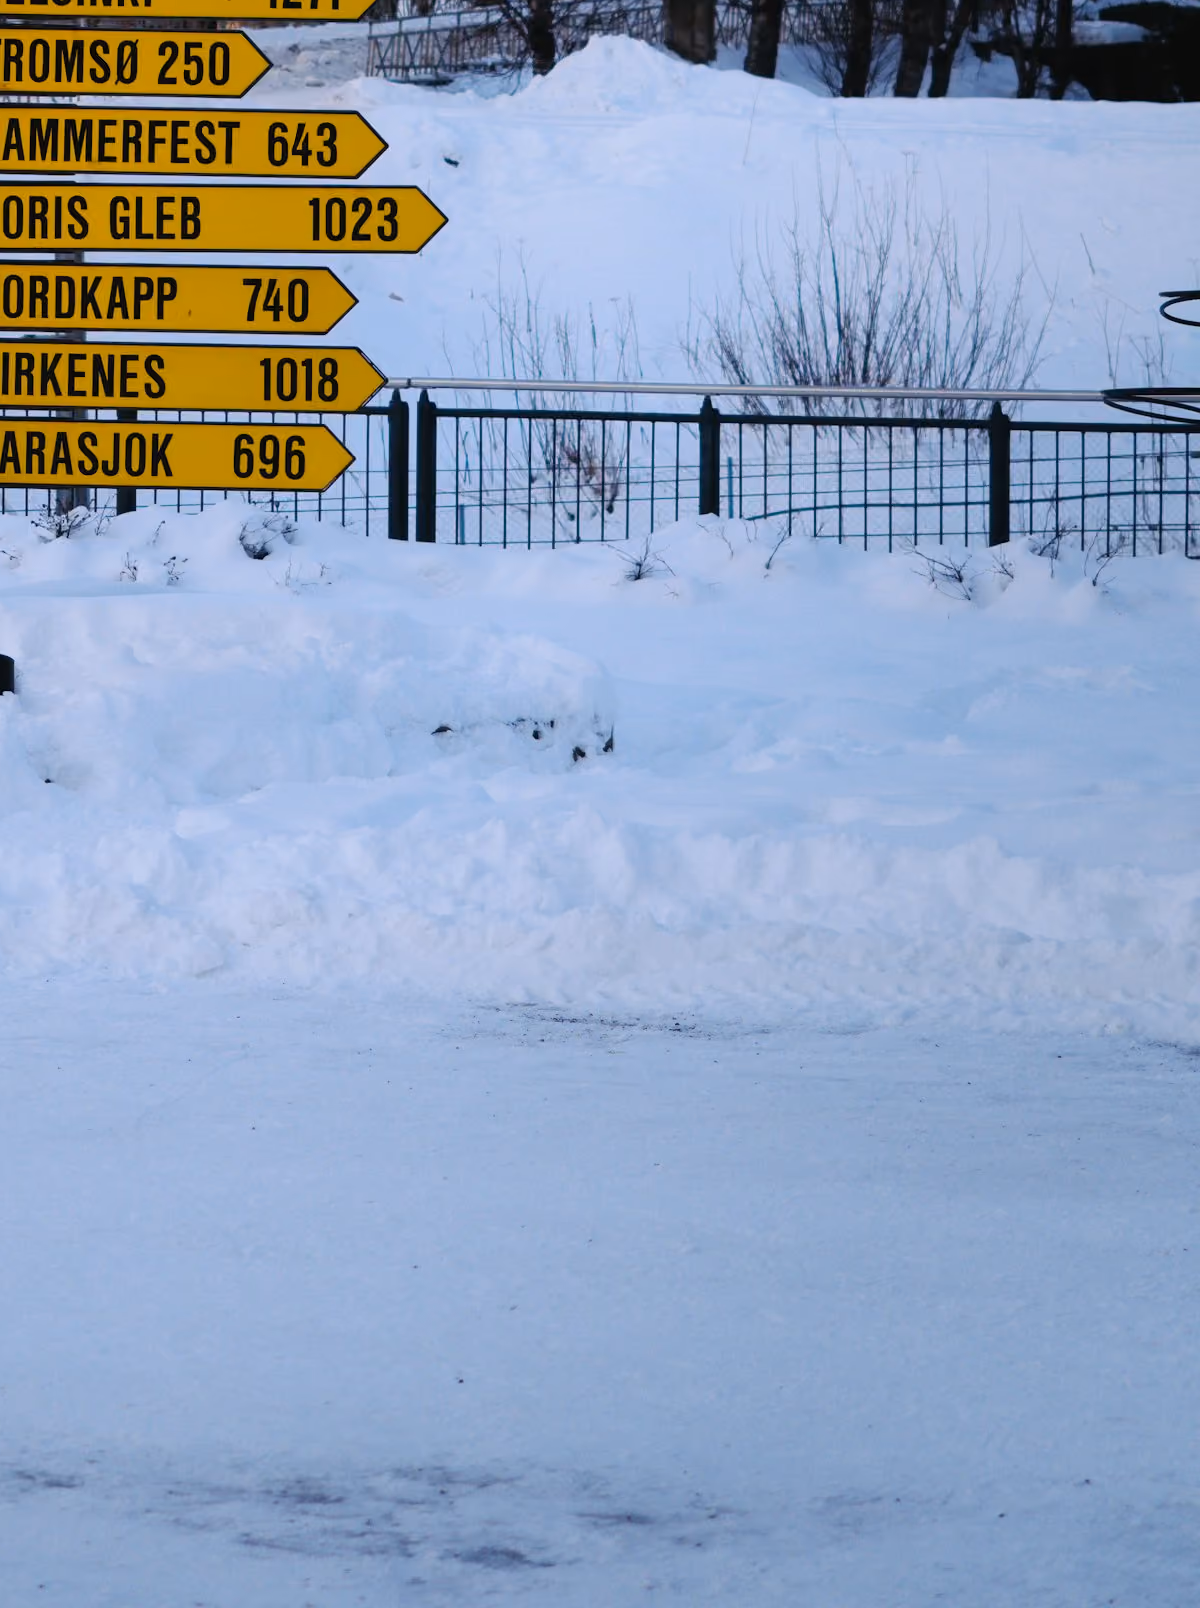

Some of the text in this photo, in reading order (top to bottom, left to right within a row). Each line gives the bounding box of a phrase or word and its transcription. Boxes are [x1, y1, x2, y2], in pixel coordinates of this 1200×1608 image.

[158, 41, 229, 85] 250
[268, 122, 337, 166] 643
[110, 196, 200, 239] GLEB
[309, 197, 398, 241] 1023
[243, 279, 308, 322] 740
[260, 358, 338, 402] 1018
[234, 434, 305, 480] 696
